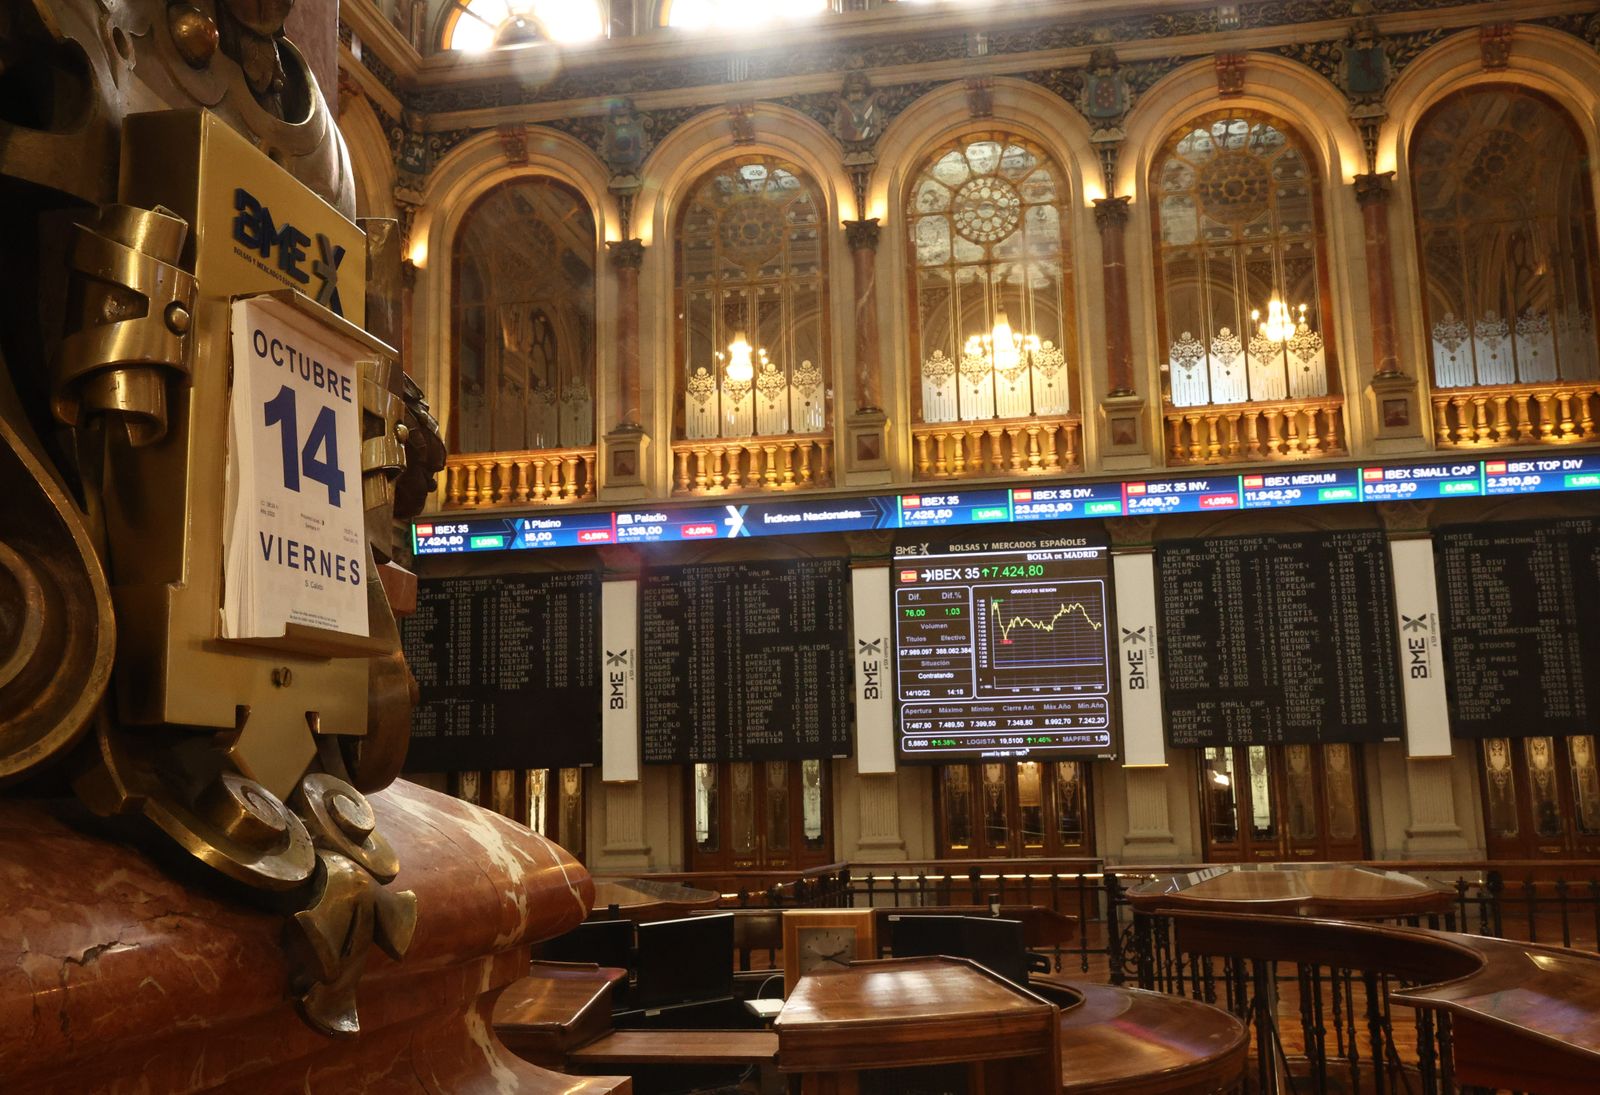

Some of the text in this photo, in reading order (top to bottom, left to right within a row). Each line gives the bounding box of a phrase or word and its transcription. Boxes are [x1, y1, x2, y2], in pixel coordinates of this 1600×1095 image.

[254, 329, 352, 403] OCTUBRE
[264, 384, 346, 508] 14
[1508, 459, 1583, 472] IBEX TOP DIV
[1385, 465, 1476, 480] IBEX SMALL CAP
[1264, 474, 1336, 487] IBEX MEDIUM
[1487, 476, 1541, 488] 2.310,80
[1147, 481, 1210, 493] IBEX 35 INV.
[1033, 488, 1094, 500] IBEX 35 DIV.
[921, 496, 960, 506] IBEX 35
[634, 514, 667, 523] Paladio
[764, 510, 862, 523] Índices Nacionales
[435, 524, 469, 534] IBEX 35
[532, 520, 561, 529] Platino
[417, 536, 463, 546] 7.424,80
[949, 543, 980, 552] BOLSAS
[991, 541, 1036, 550] MERCADOS
[1040, 538, 1086, 548] ESPAÑOLES
[1204, 538, 1263, 547] COTIZACIONES
[895, 545, 917, 555] BME
[1027, 553, 1053, 561] BOLSA
[1063, 550, 1098, 559] MADRID
[260, 531, 361, 585] VIERNES
[1185, 554, 1215, 562] MEDIUM
[931, 564, 1044, 581] IBEX 35 7.424,80
[908, 592, 962, 601] Dif. Dif.%
[1408, 637, 1428, 679] BME
[1127, 649, 1145, 690] BME
[863, 661, 879, 700] BME
[917, 672, 954, 680] Contratando
[609, 671, 624, 710] BME
[905, 708, 932, 716] Apertura
[1078, 717, 1105, 725] 7.242,20
